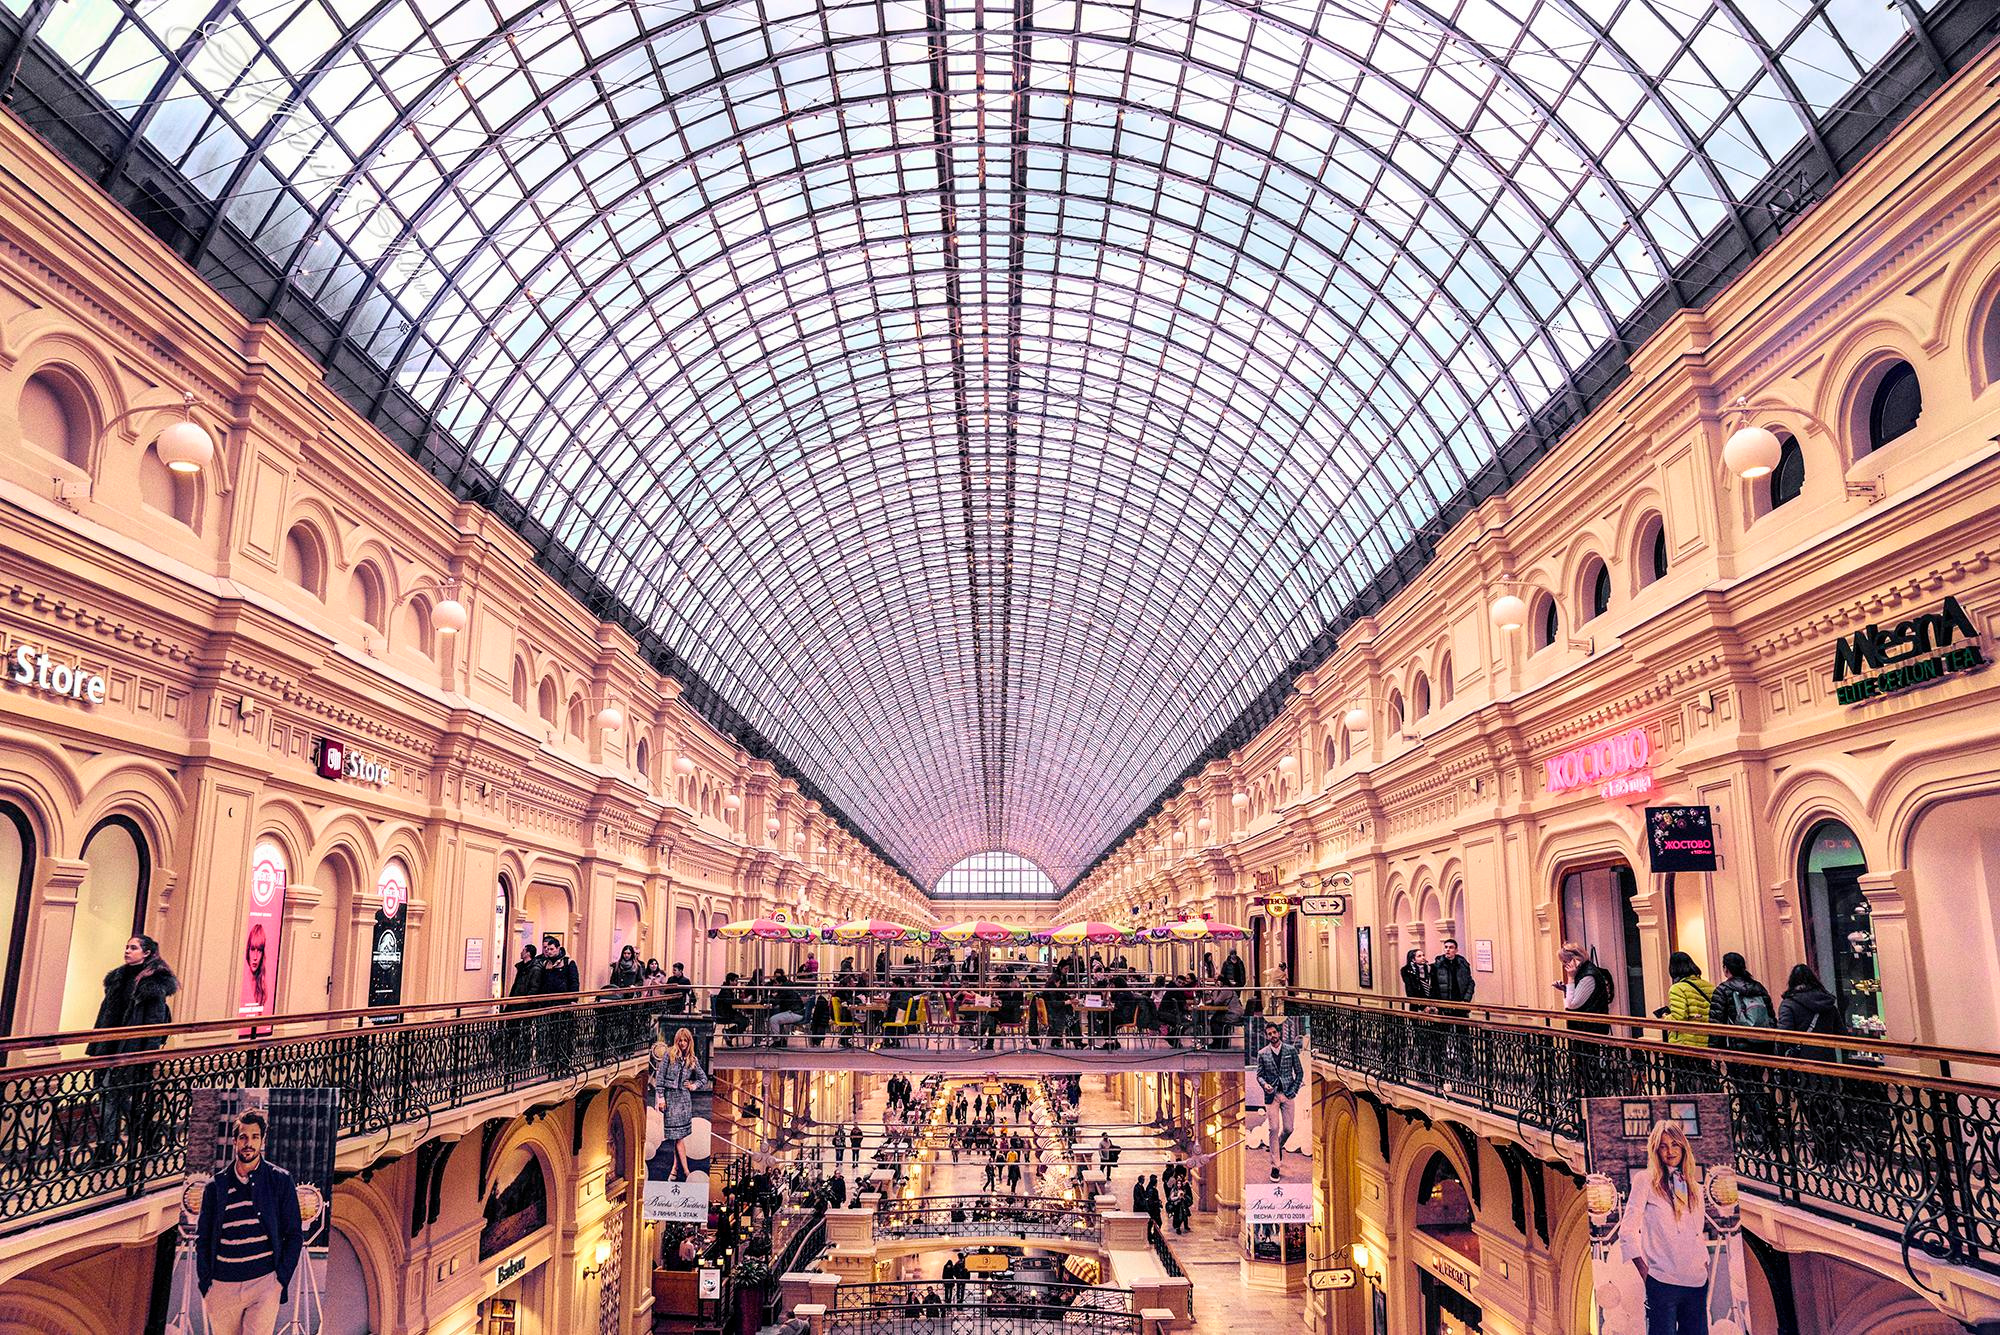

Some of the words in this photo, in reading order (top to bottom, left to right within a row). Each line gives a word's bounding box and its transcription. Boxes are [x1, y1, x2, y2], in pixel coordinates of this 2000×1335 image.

[15, 645, 105, 704] Store
[1836, 678, 1877, 706] ELITE
[1877, 657, 1943, 693] CEYLON
[1944, 646, 1983, 673] TEA
[350, 752, 389, 785] Store
[1545, 728, 1649, 792] ЖОСТОВО
[1664, 840, 1711, 850] ЖОСТОВО
[646, 1195, 672, 1208] Brooks
[676, 1196, 707, 1209] Brothers
[1248, 1198, 1276, 1210] Brooks
[1280, 1198, 1312, 1210] Brothers
